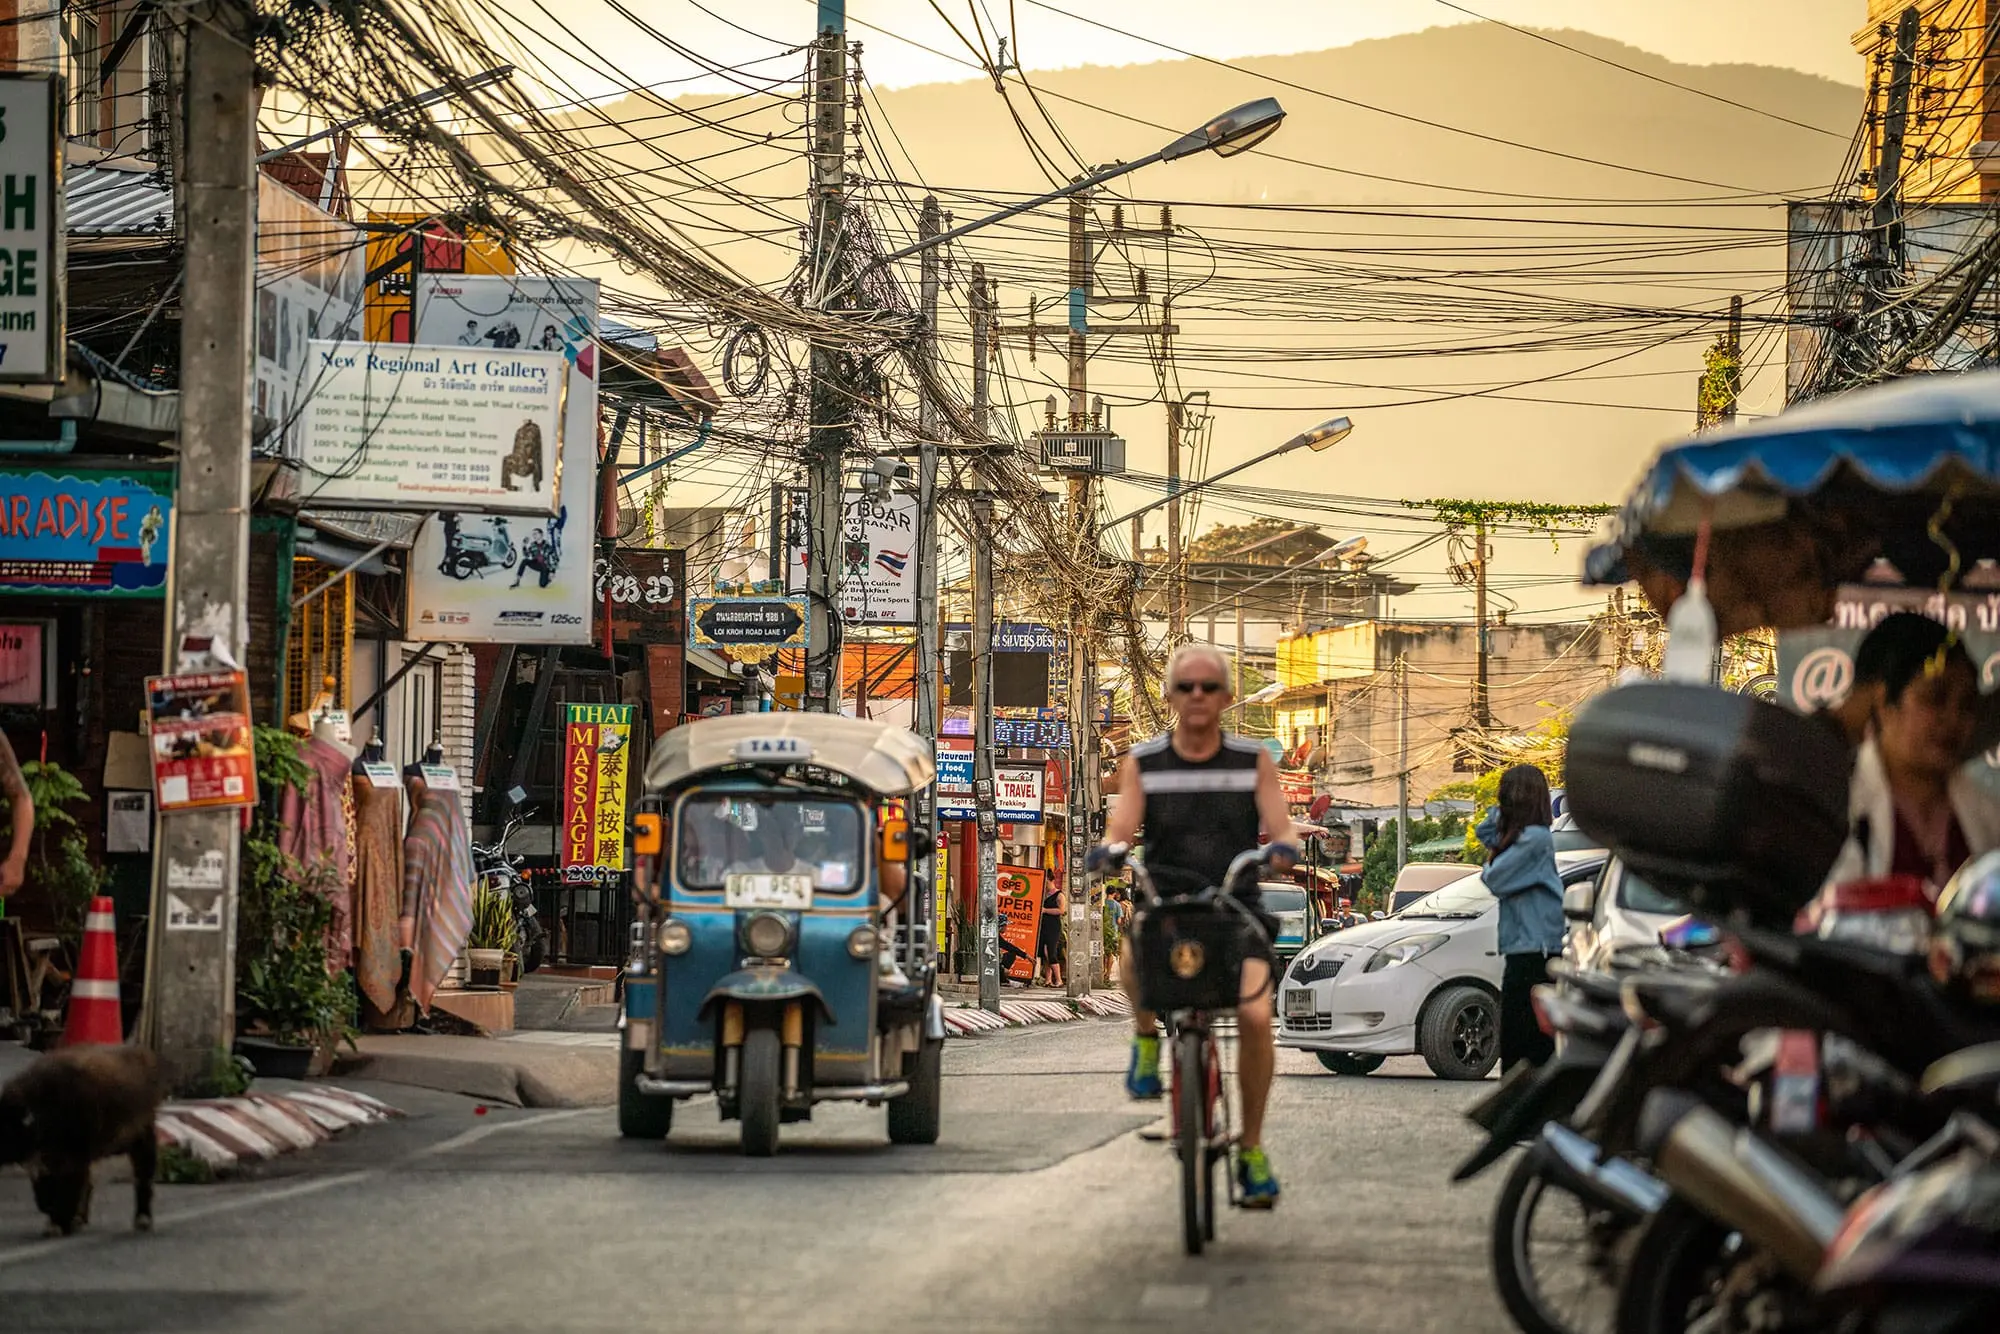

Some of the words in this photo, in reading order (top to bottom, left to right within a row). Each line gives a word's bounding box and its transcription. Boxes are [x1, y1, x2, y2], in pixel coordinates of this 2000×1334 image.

[320, 351, 355, 368] New
[366, 354, 440, 375] Regional
[448, 359, 477, 375] Art
[485, 360, 549, 382] Gallery
[472, 399, 489, 408] and
[860, 500, 911, 533] BOAR
[550, 614, 582, 624] 125cc
[571, 705, 629, 723] THAI
[751, 740, 797, 751] TAXI
[945, 762, 966, 774] food,
[570, 727, 594, 862] MASSAGE
[1004, 783, 1037, 798] TRAVEL
[595, 753, 624, 864] 泰式按摩
[1001, 880, 1022, 891] SPE
